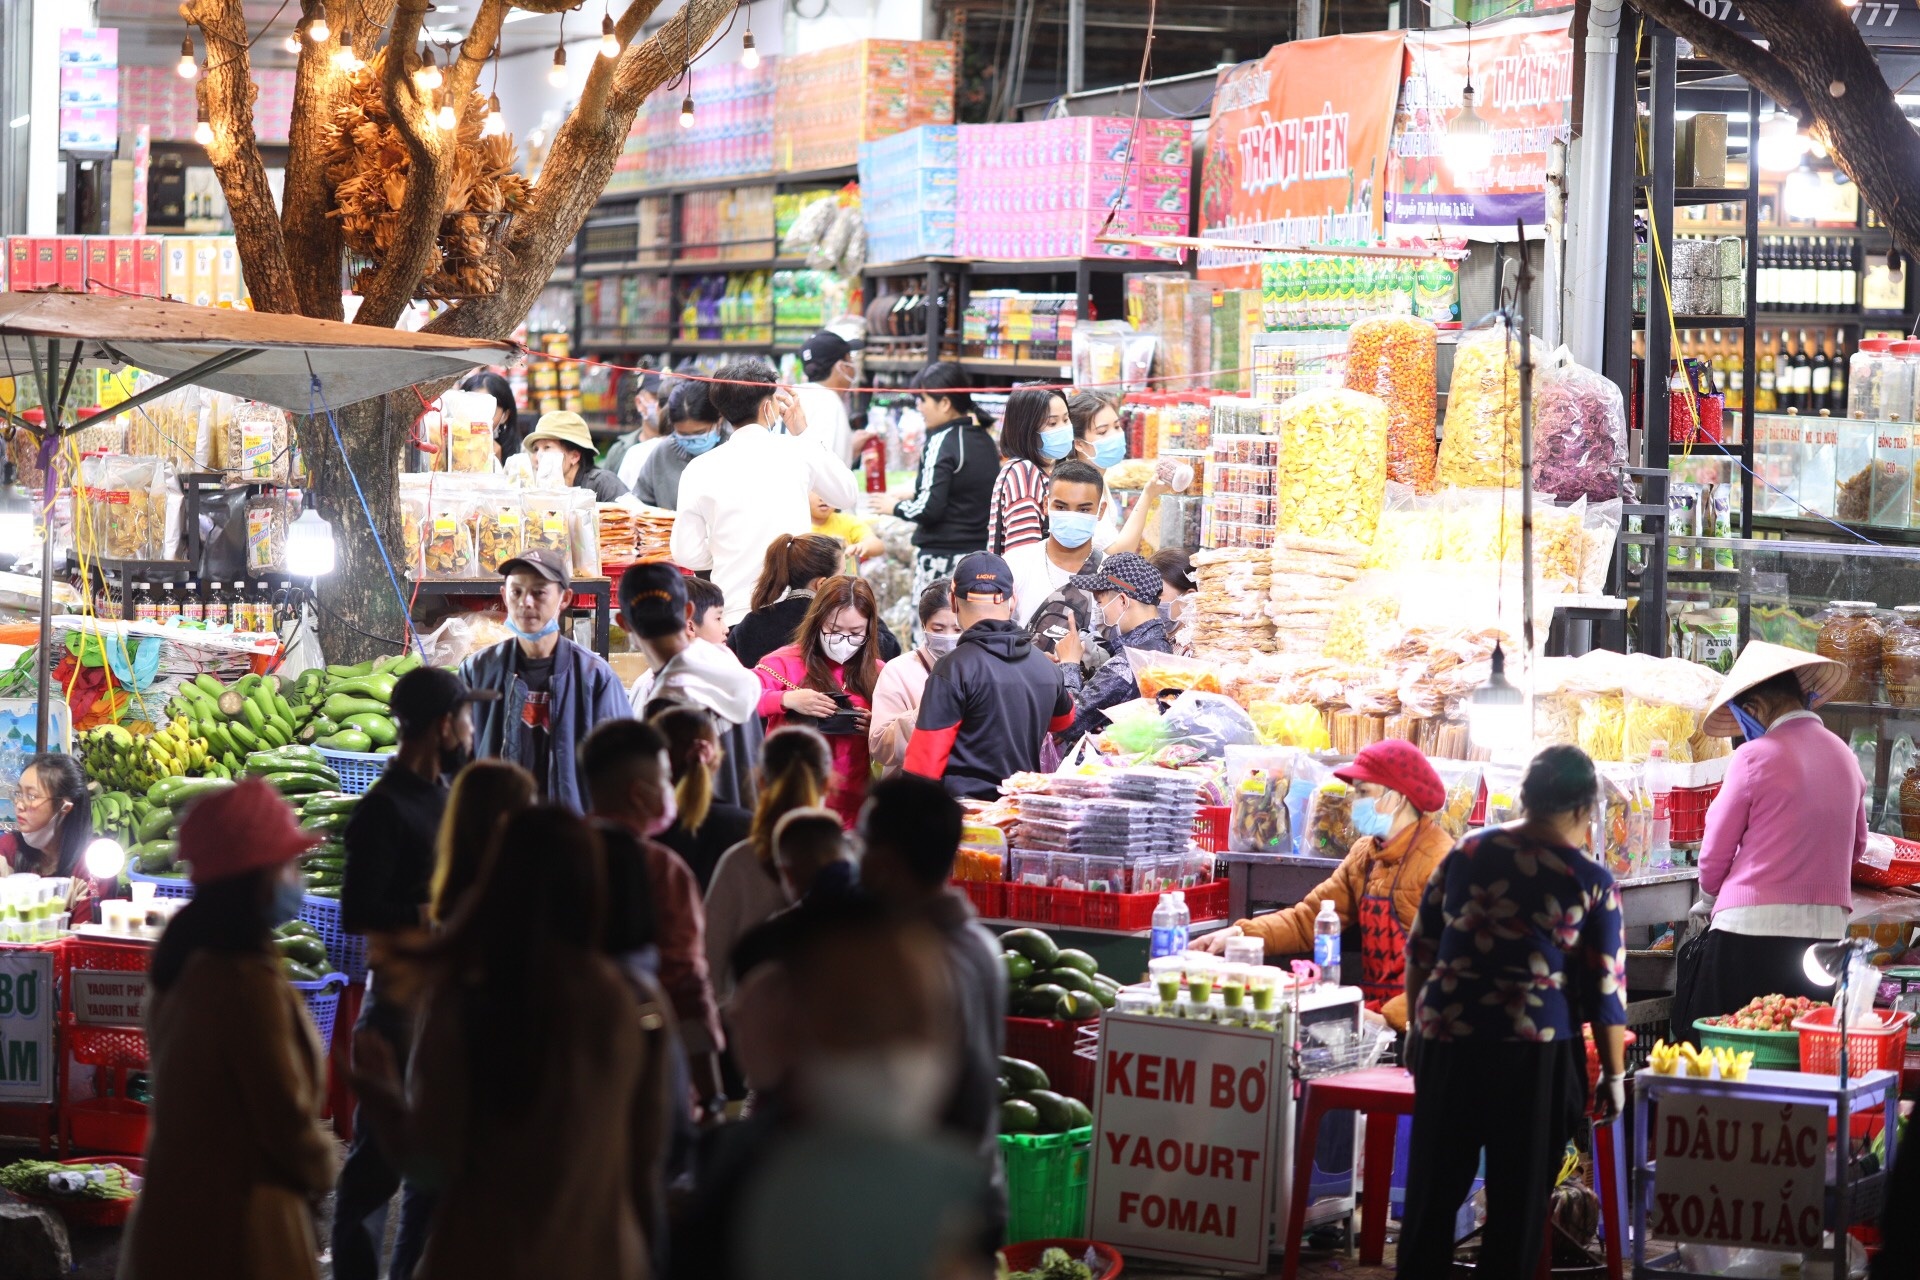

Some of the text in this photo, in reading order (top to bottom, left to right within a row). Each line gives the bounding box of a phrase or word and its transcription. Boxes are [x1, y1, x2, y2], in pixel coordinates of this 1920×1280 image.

[1238, 111, 1300, 194] THÀNH
[1706, 637, 1731, 646] ATISÔ
[87, 983, 124, 996] YAOURT
[87, 1004, 123, 1017] YAOURT
[1106, 1050, 1266, 1114] KEM BƠ
[1105, 1132, 1260, 1182] YAOURT
[1664, 1103, 1818, 1168] DÂU LẮC
[1118, 1192, 1236, 1238] FOMAI
[1654, 1179, 1820, 1247] XOÀI LẮC
